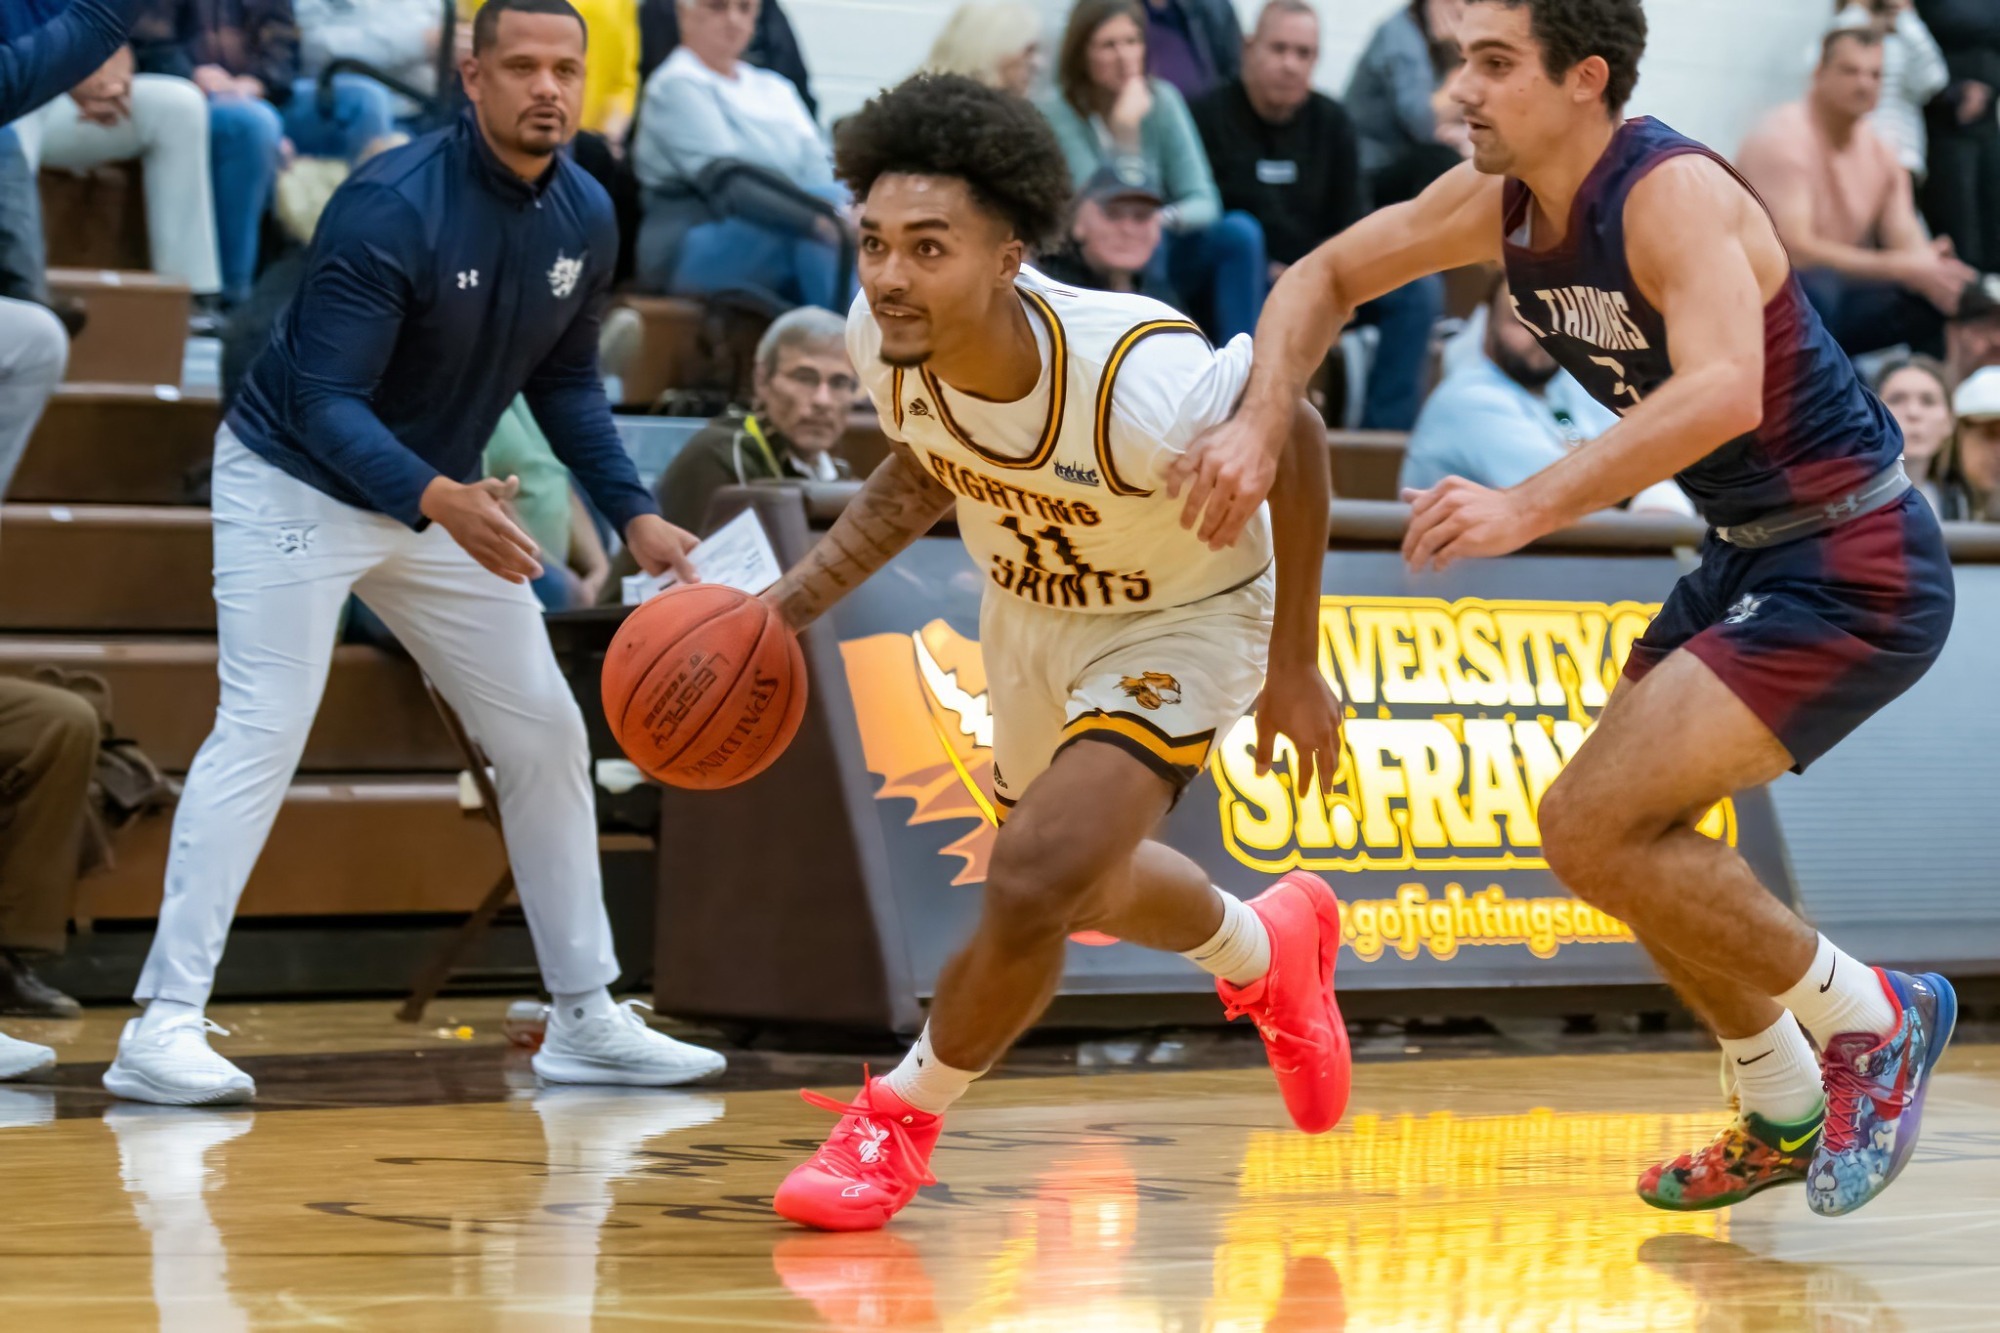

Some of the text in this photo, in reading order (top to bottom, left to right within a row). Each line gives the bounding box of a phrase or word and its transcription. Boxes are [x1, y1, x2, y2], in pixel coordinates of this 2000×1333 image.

[1534, 285, 1650, 351] THOMAS
[926, 449, 1102, 527] FIGHTING
[996, 514, 1093, 577] 11
[990, 554, 1152, 607] SAINTS
[650, 652, 730, 750] LEGACY
